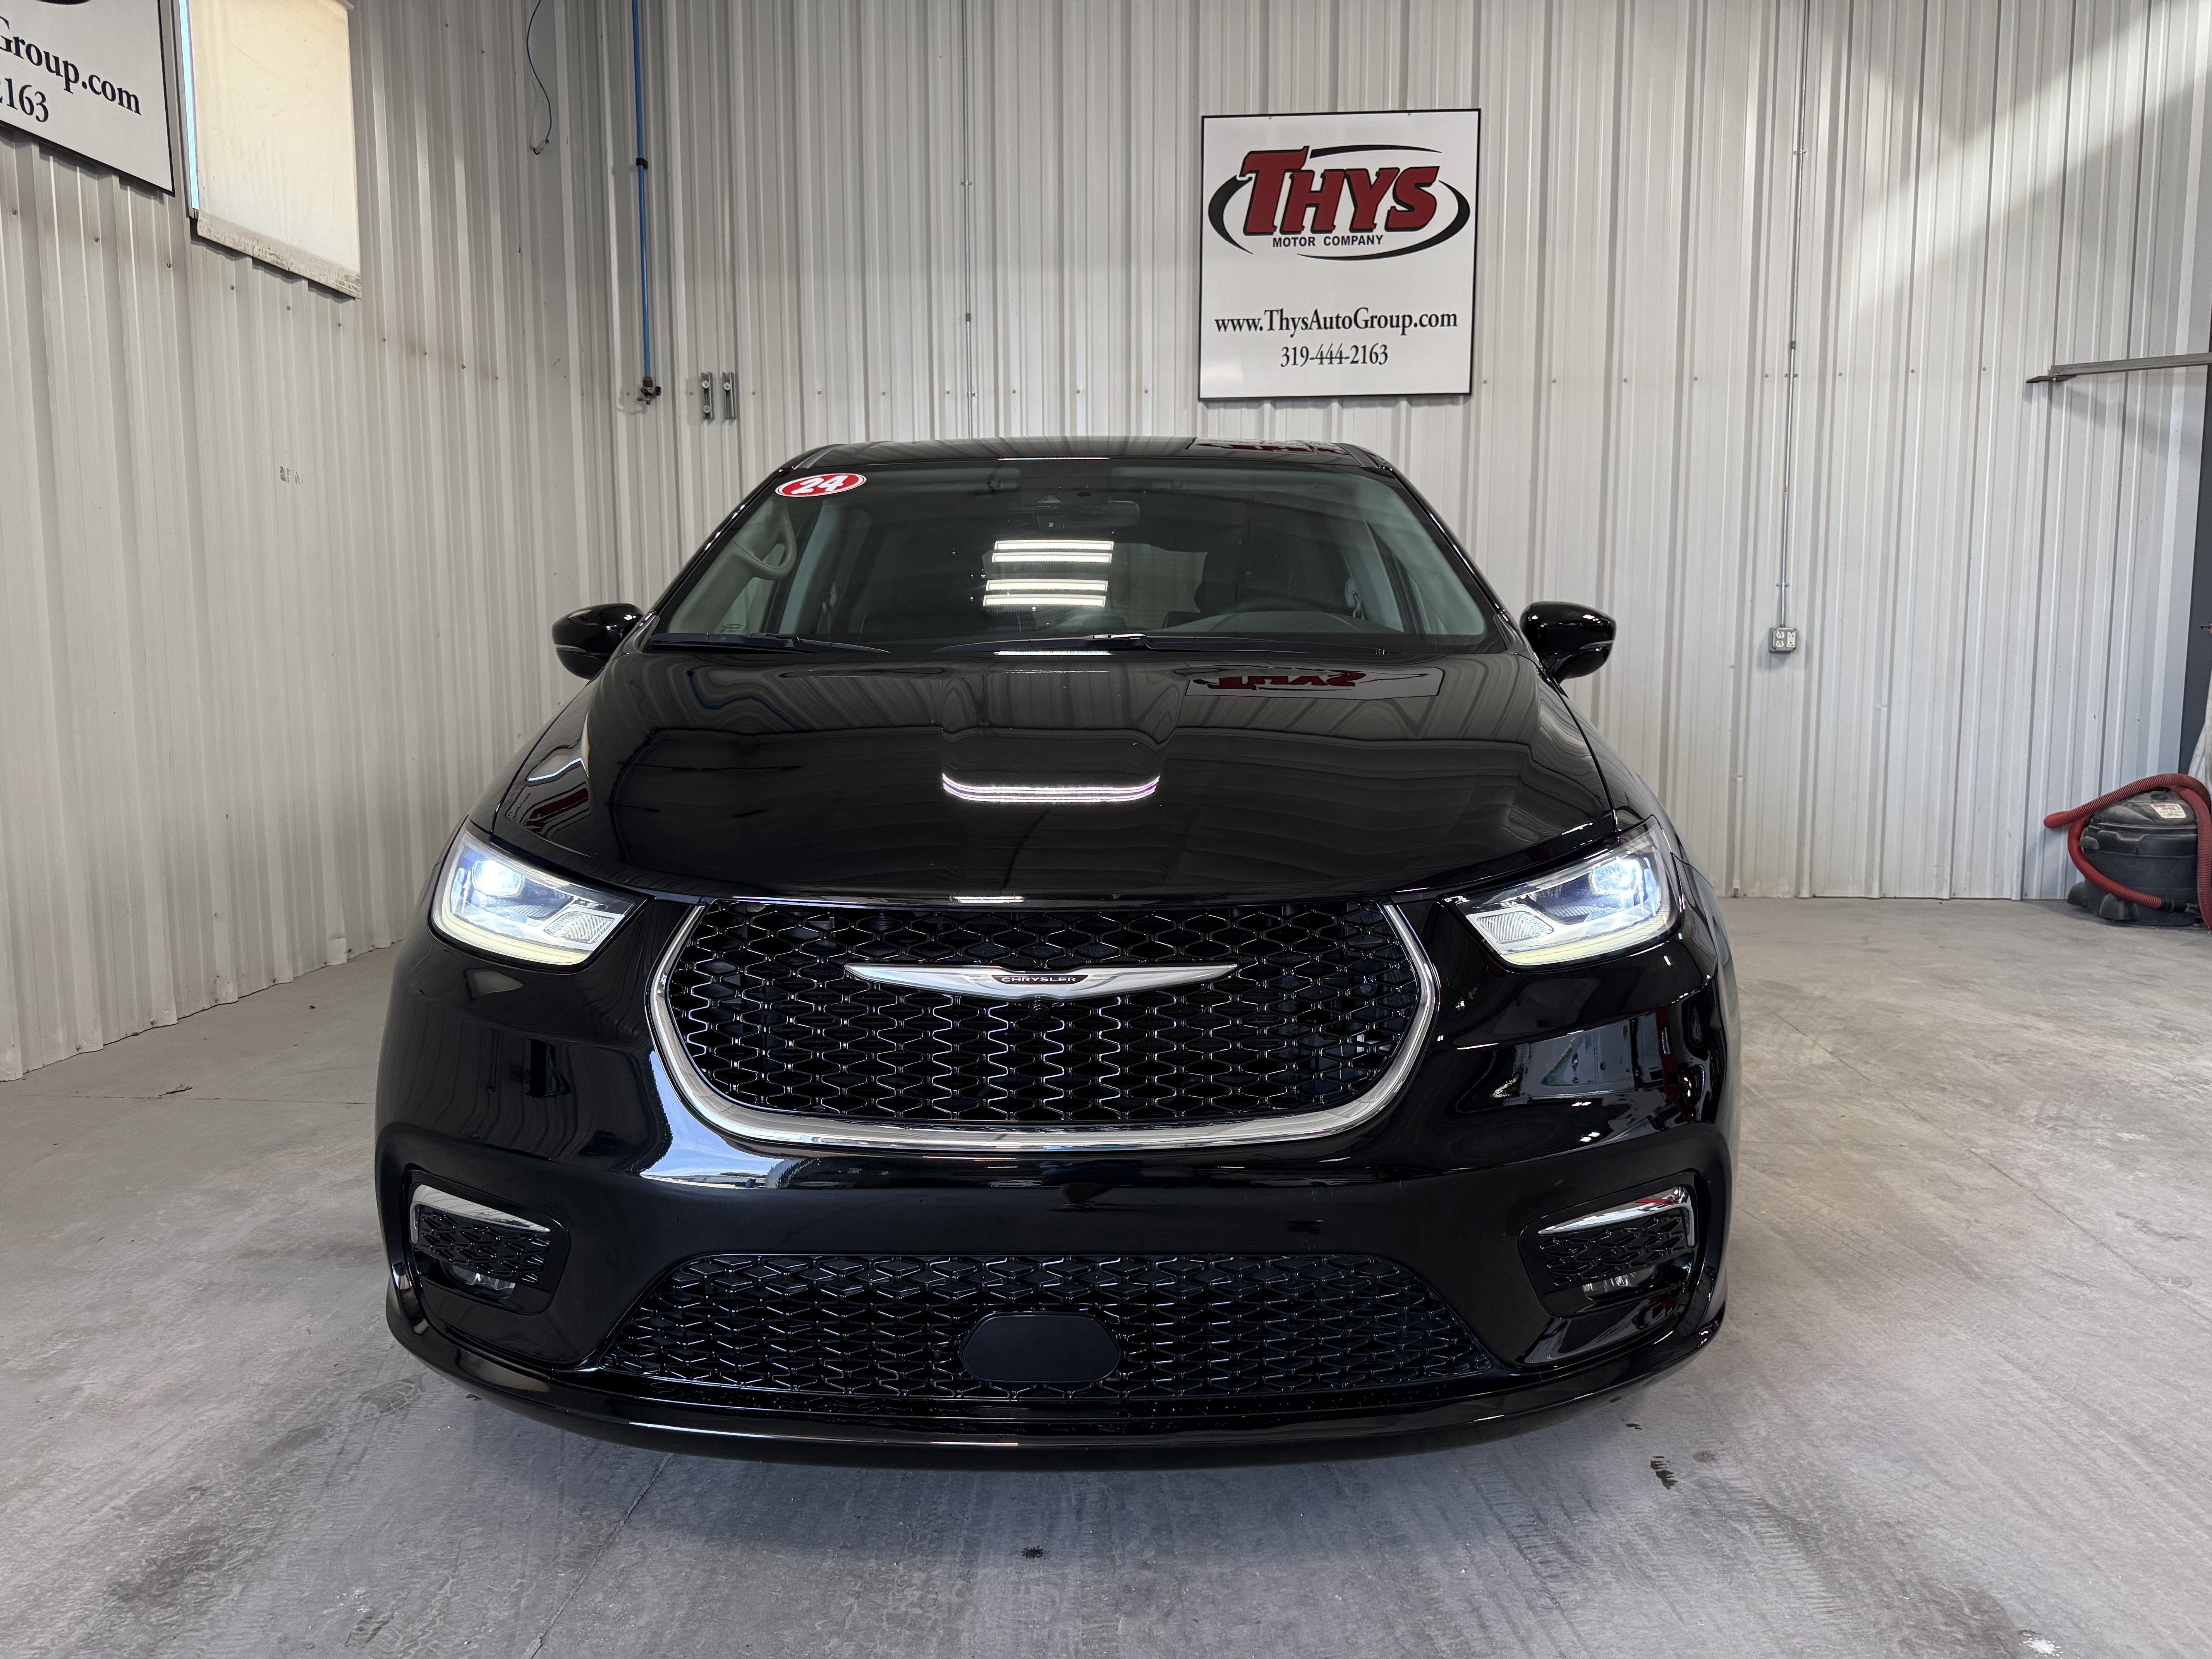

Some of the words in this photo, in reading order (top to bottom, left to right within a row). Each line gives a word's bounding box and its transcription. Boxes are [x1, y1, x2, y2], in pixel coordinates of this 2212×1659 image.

[0, 78, 49, 122] 163
[1240, 146, 1440, 236] THYS
[1273, 236, 1316, 248] MOTOR
[1323, 235, 1383, 246] COMPANY
[1214, 307, 1458, 337] www.ThysAutoGroup.com
[1280, 343, 1388, 367] 319-444-2163
[791, 475, 849, 495] 24
